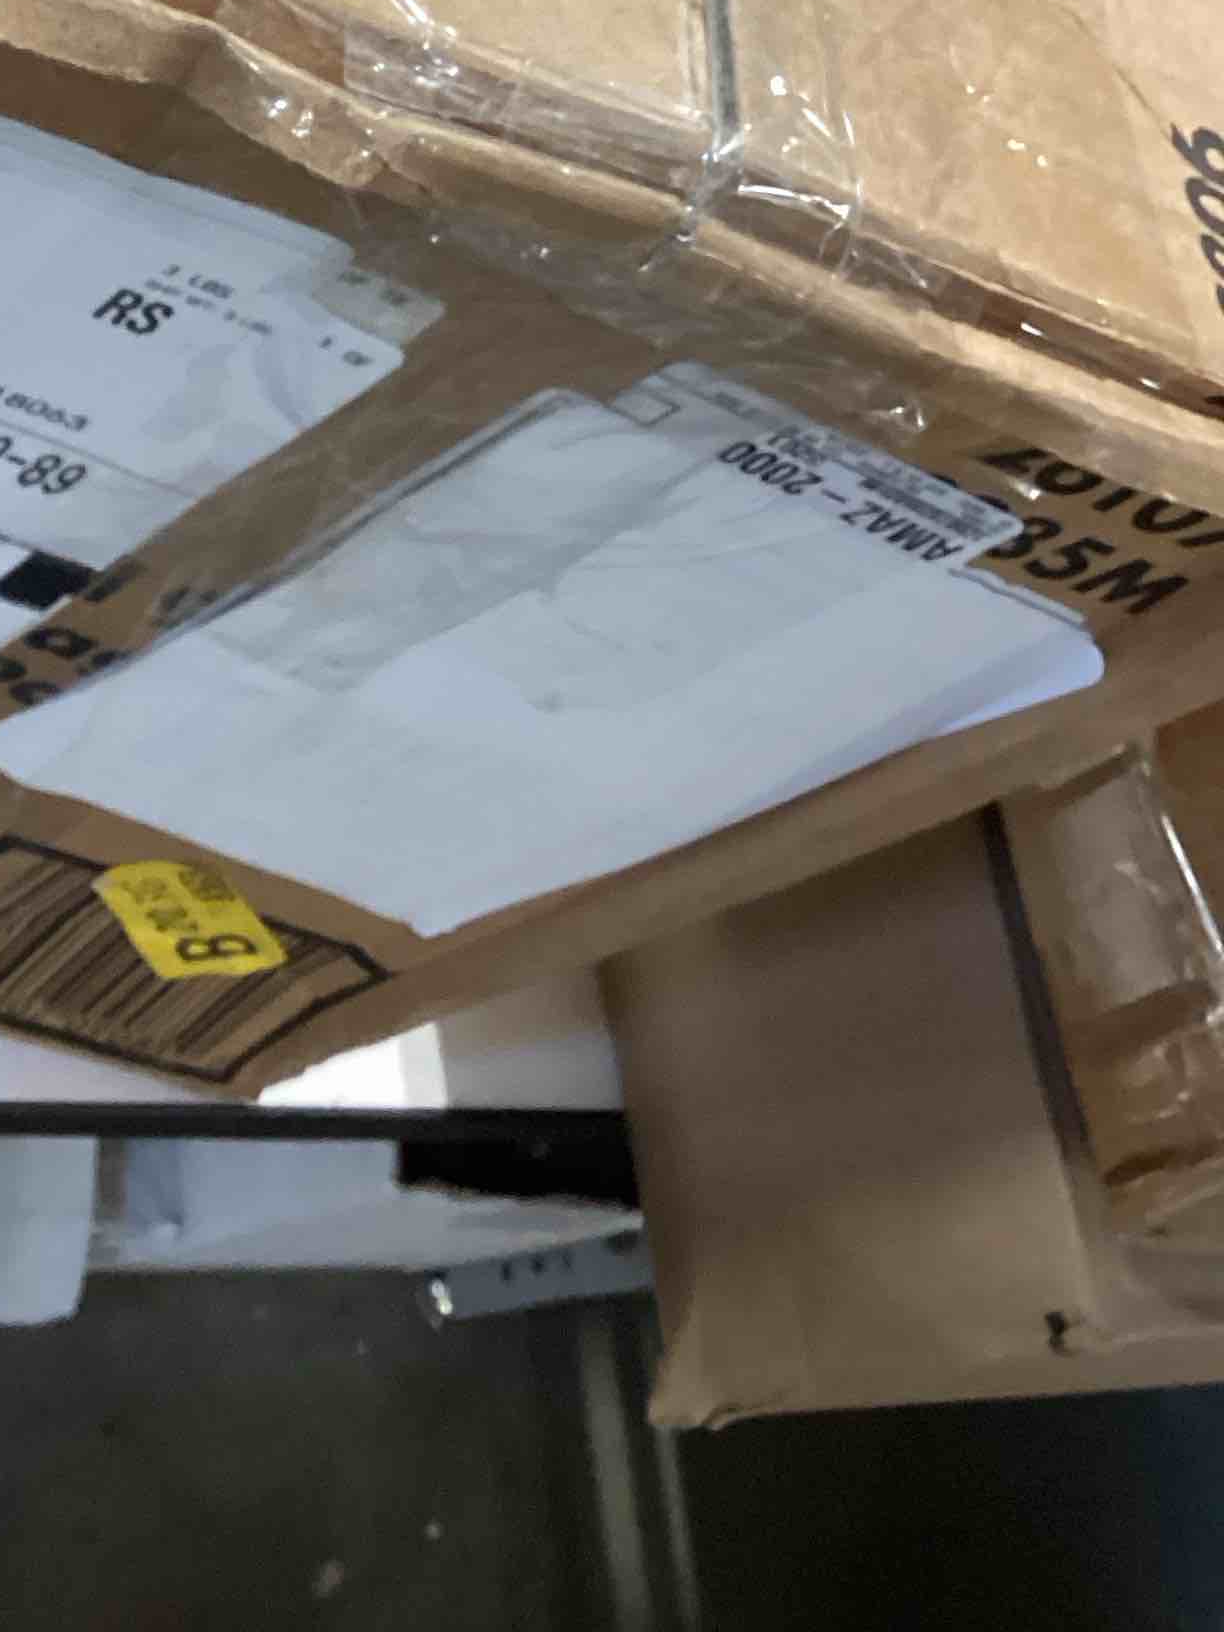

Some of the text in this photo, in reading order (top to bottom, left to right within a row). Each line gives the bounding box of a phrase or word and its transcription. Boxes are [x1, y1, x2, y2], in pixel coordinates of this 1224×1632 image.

[91, 286, 176, 338] RS
[717, 439, 824, 497] 2000
[839, 498, 965, 562] AMAZ
